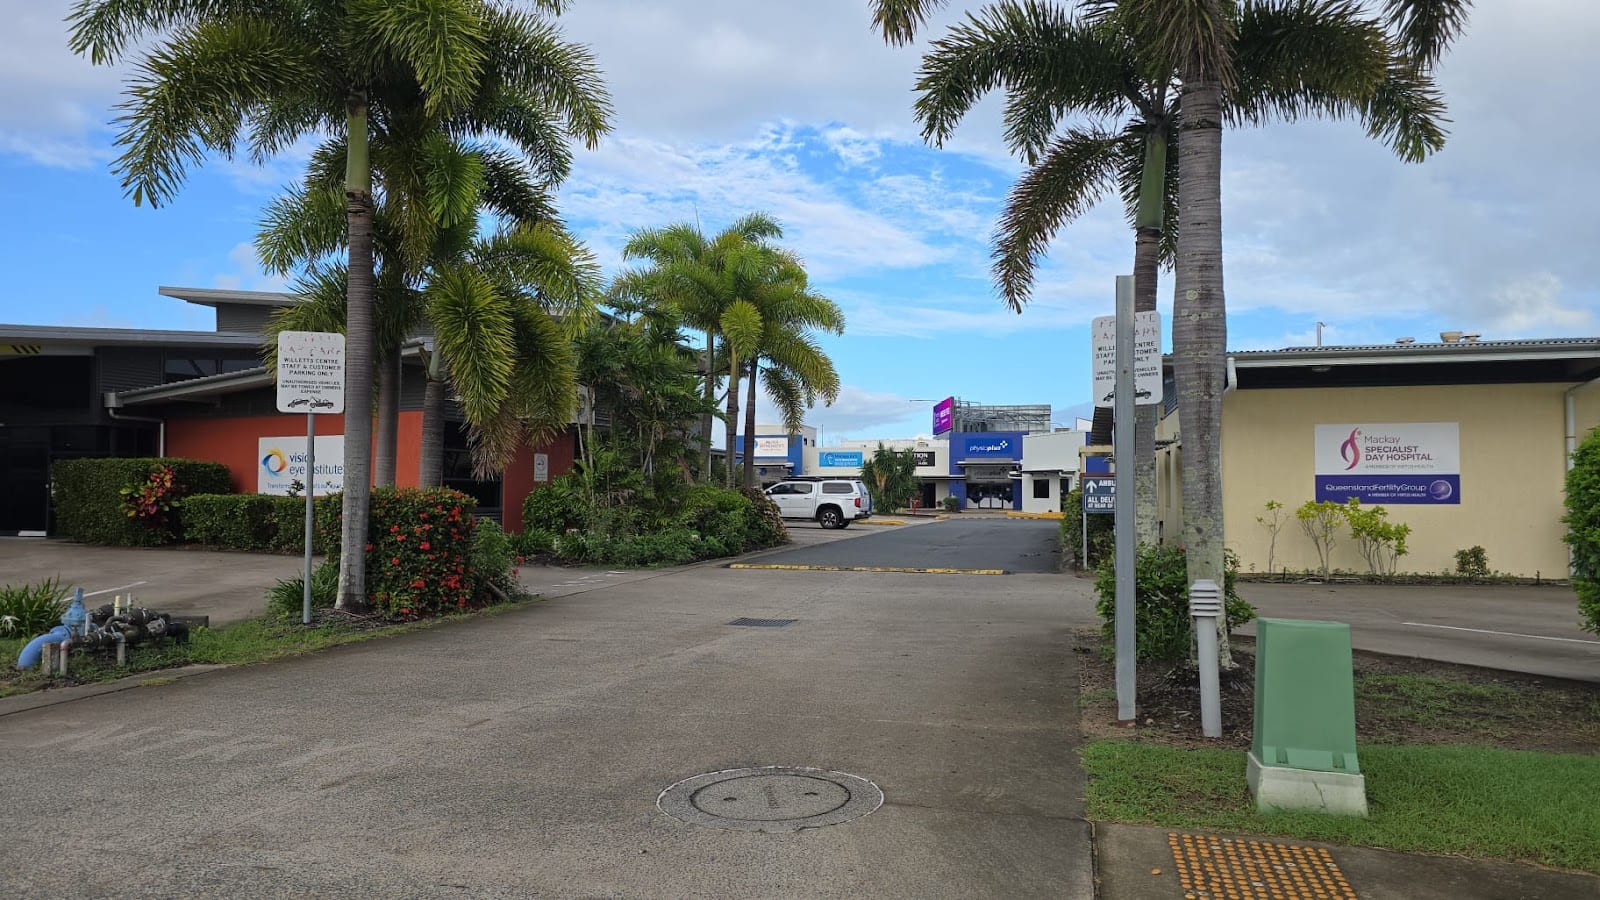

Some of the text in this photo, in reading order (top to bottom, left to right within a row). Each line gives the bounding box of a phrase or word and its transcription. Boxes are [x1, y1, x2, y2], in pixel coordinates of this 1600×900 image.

[1365, 436, 1400, 444] Mackay
[970, 444, 1001, 452] physioplus
[290, 466, 305, 476] eye
